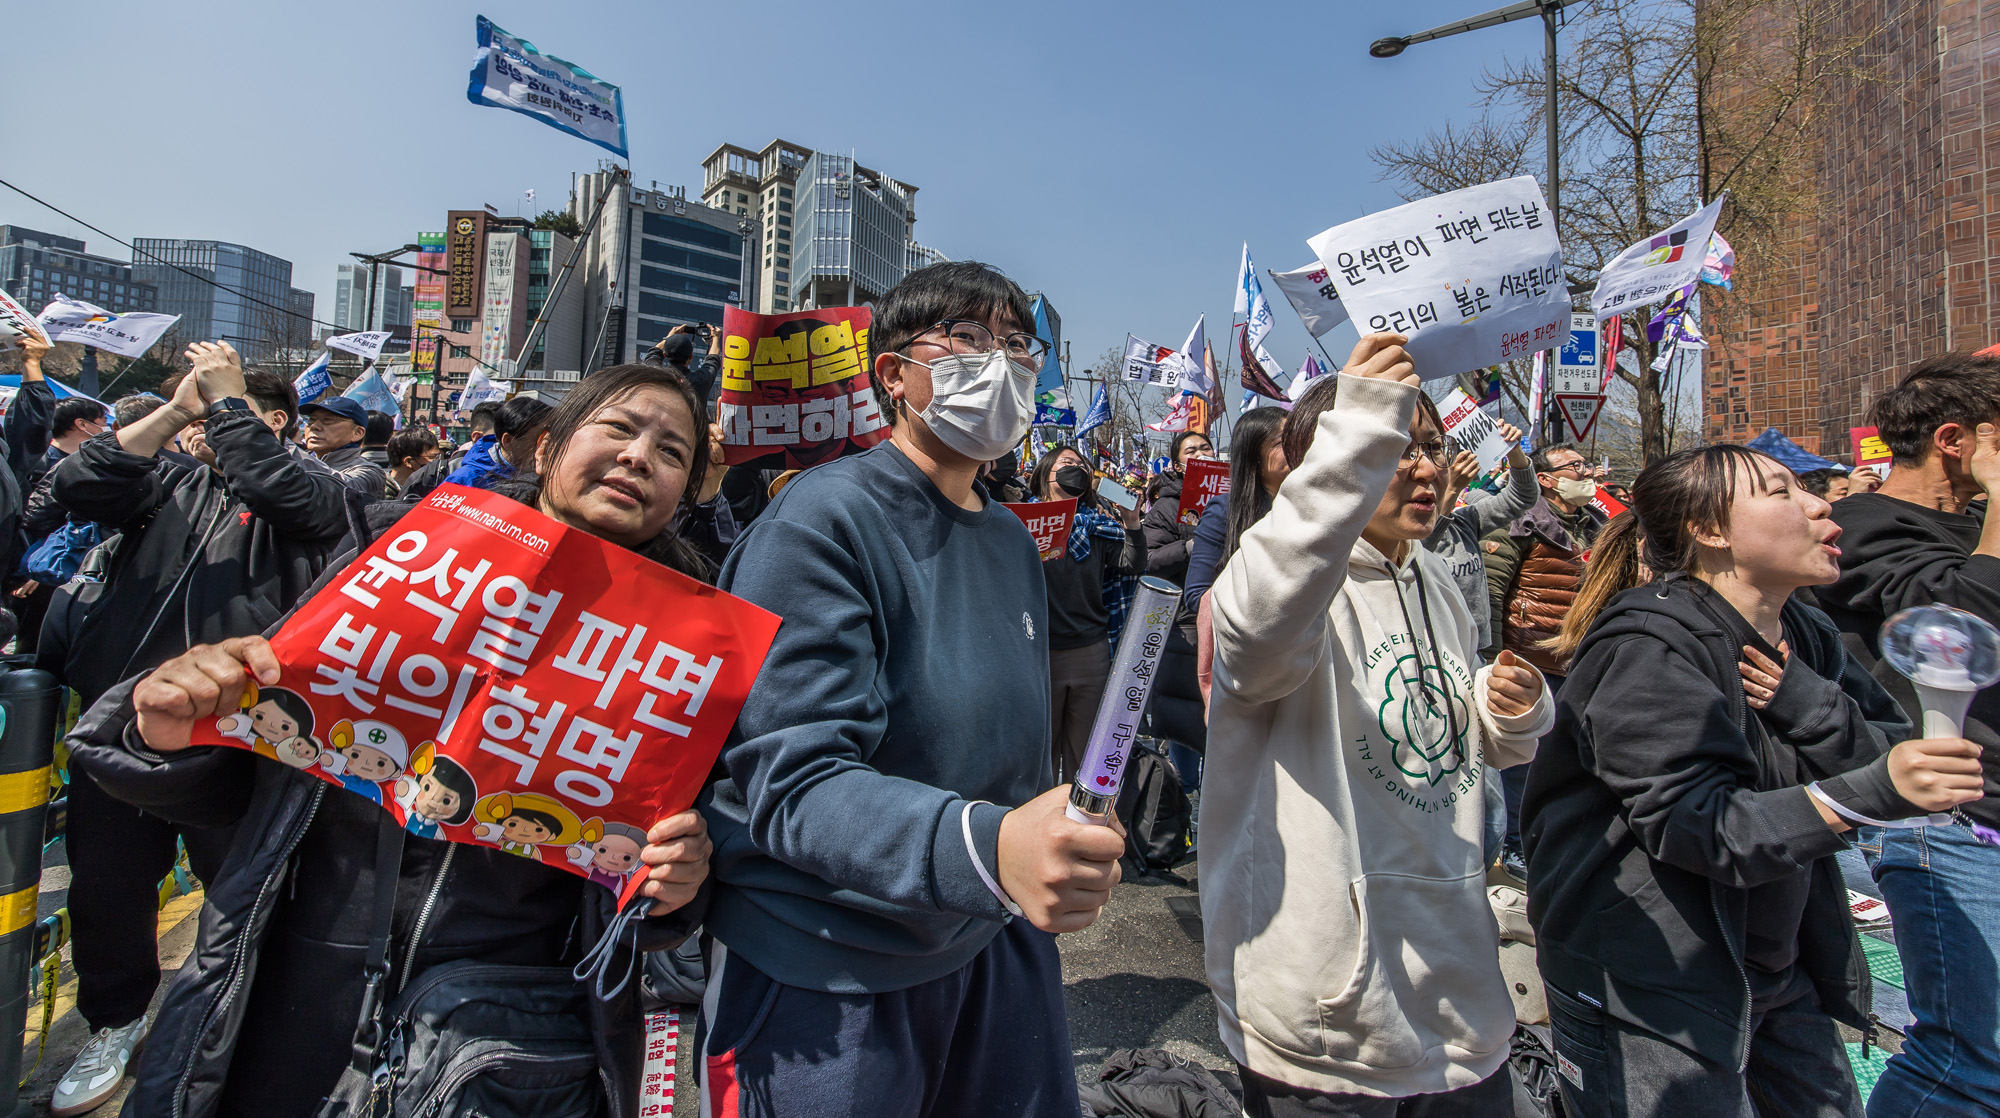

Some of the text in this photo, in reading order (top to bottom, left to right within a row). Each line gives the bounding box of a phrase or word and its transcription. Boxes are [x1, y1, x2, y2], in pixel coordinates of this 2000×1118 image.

[656, 195, 686, 215] 동일
[1337, 201, 1543, 287] 윤석열이 파면 되는날
[1368, 301, 1439, 334] 우리의
[1499, 264, 1562, 300] 시작된다!
[1572, 317, 1596, 328] 곡로
[1500, 320, 1563, 358] 윤석열 파면!
[1557, 368, 1598, 379] 자전거우선도로
[1570, 401, 1593, 412] 천천히
[1574, 412, 1588, 420] SLOW
[1442, 405, 1467, 433] 란동조
[1199, 474, 1231, 494] 새봄
[457, 503, 551, 553] www.nanum.com
[1026, 512, 1067, 536] 파면
[340, 528, 724, 739] 윤석열 파면
[1364, 641, 1391, 670] LIFE
[309, 611, 644, 807] 빛의 혁명
[1356, 734, 1373, 761] ALL
[1367, 766, 1385, 780] AT
[1441, 791, 1458, 808] OR
[648, 1039, 665, 1061] 위험
[645, 1072, 662, 1097] 危險
